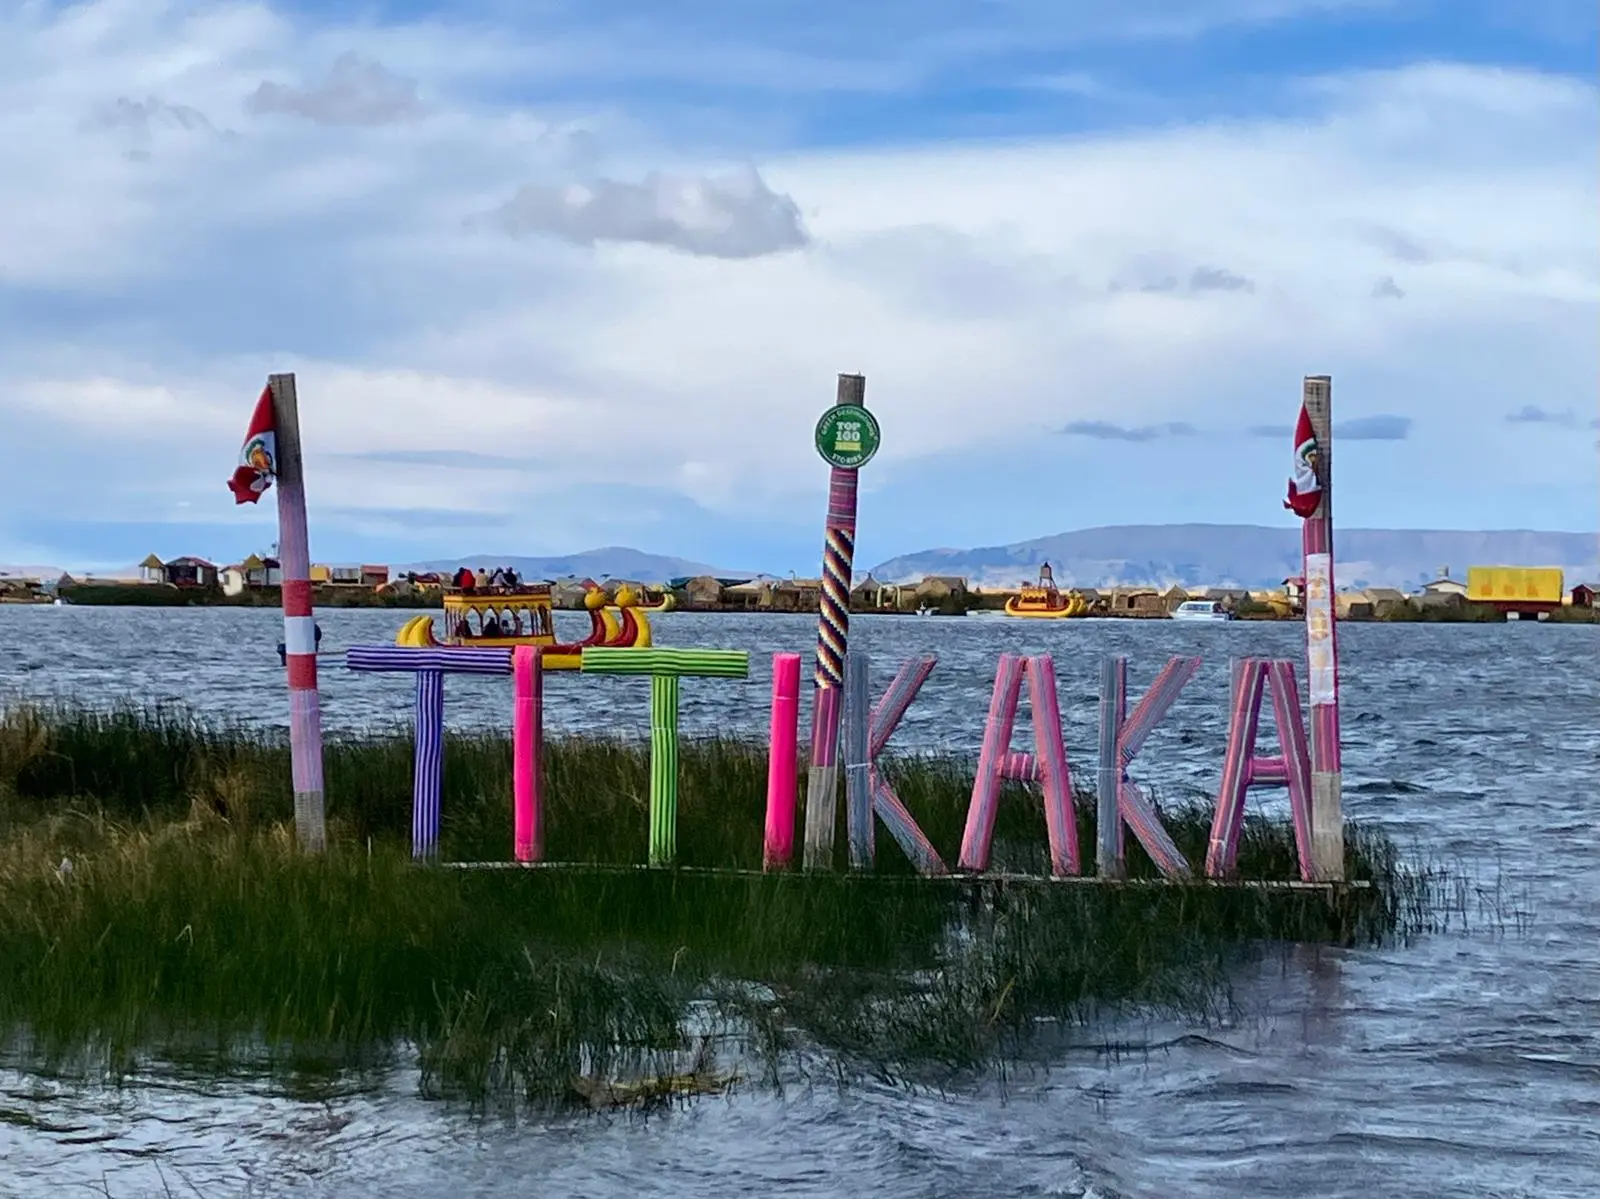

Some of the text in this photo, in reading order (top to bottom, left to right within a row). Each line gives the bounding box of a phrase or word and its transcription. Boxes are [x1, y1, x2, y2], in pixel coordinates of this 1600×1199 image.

[836, 421, 861, 430] TOP
[836, 431, 861, 441] 100
[347, 644, 1313, 881] TITIKAKA
